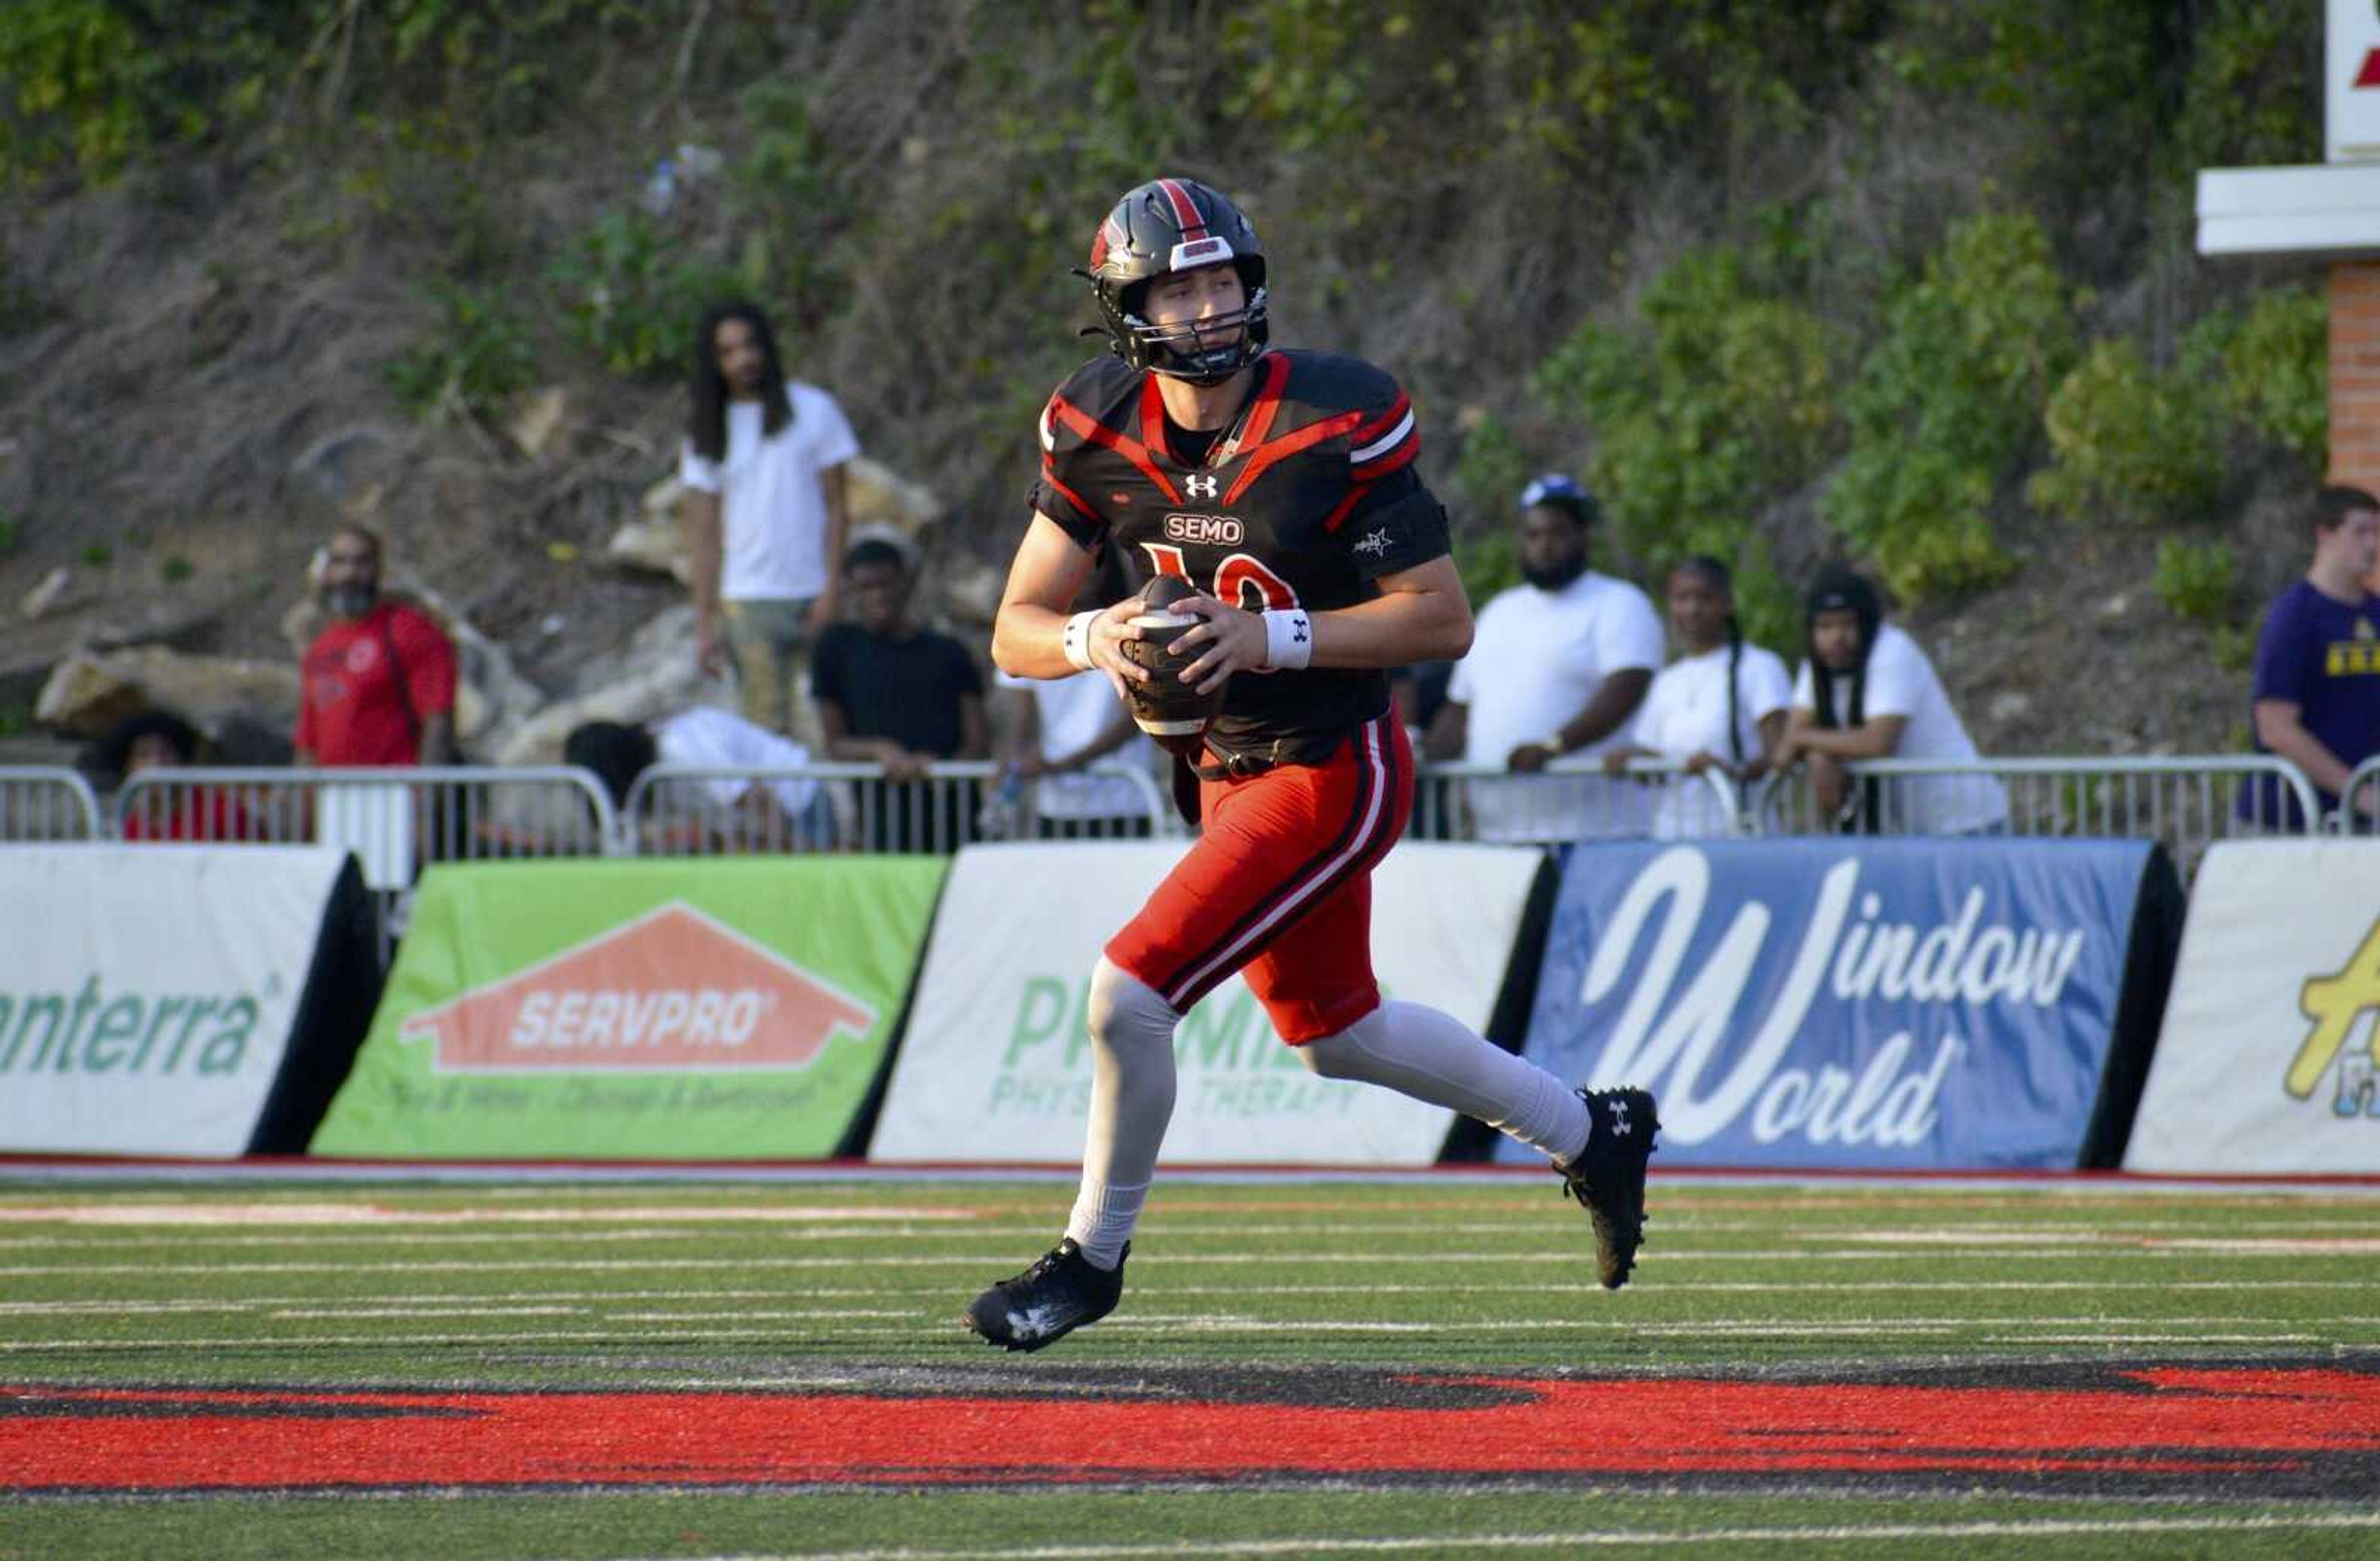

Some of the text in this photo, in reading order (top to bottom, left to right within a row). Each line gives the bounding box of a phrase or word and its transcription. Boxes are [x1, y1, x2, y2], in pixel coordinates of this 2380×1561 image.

[1166, 515, 1243, 544] SEMO
[0, 972, 260, 1074] nterra
[510, 990, 762, 1049] SERVPRO
[1581, 846, 2085, 1147] Window
